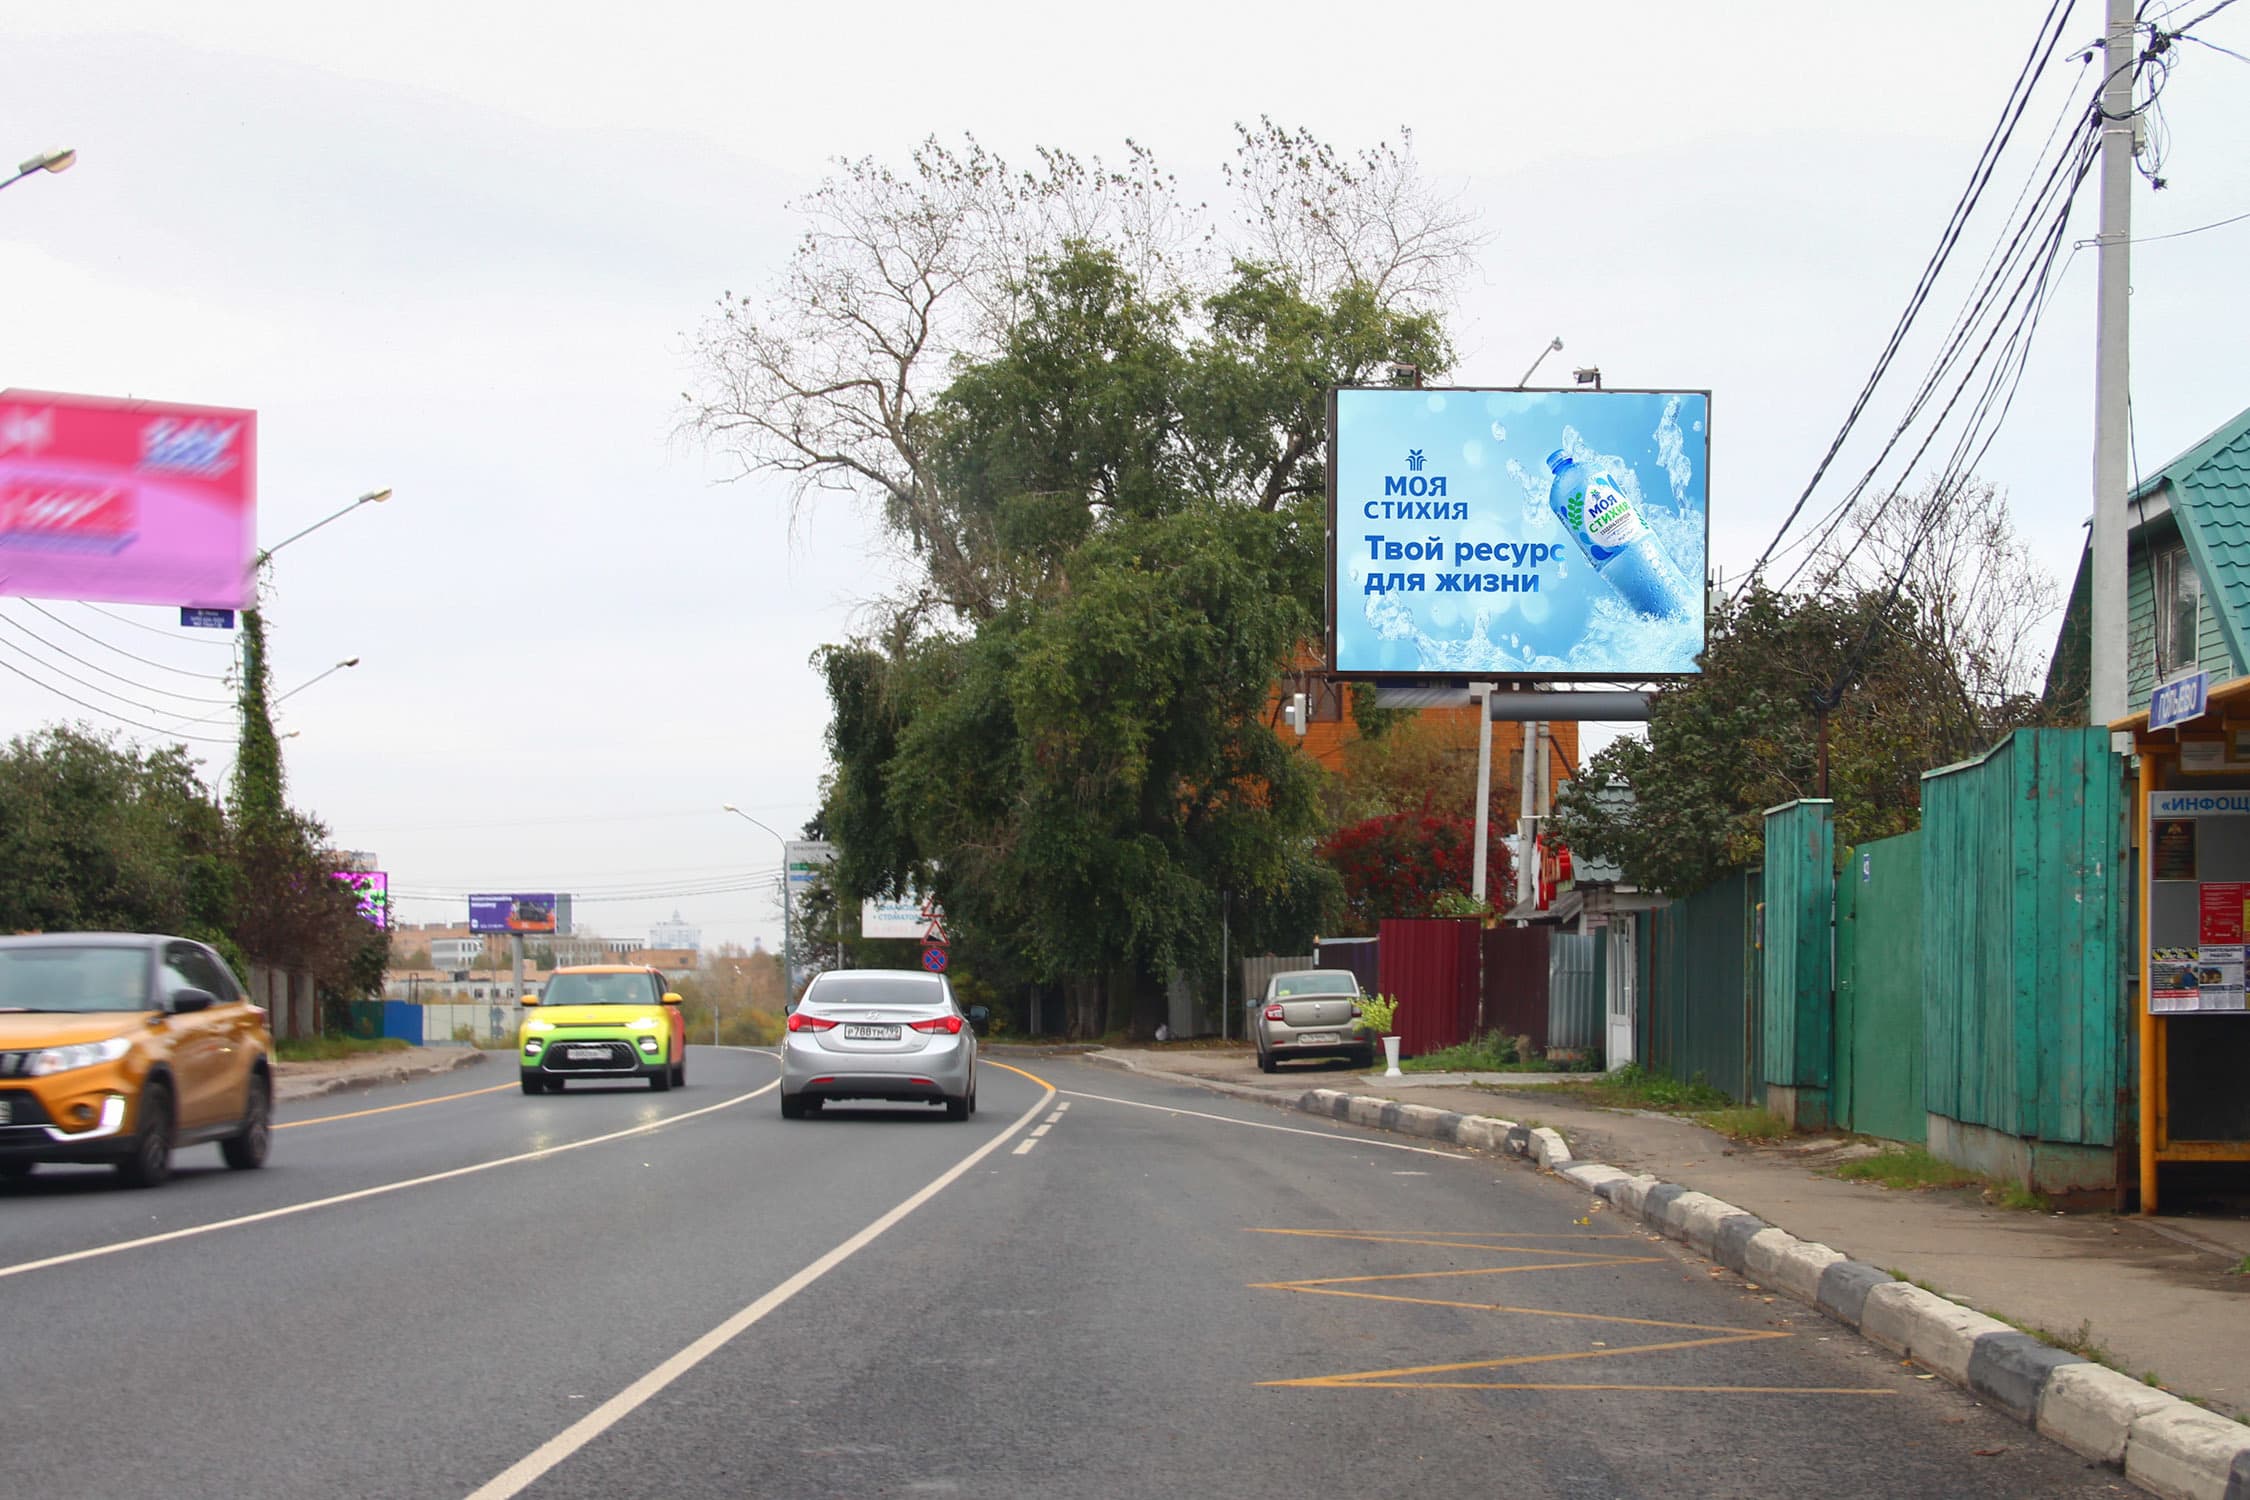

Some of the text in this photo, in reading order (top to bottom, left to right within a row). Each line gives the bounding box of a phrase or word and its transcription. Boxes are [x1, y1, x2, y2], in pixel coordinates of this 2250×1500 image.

[1384, 475, 1447, 497] МОЯ
[1363, 501, 1469, 521] СТИХИЯ
[1588, 494, 1618, 519] МОЯ
[1588, 501, 1631, 534] СТИХИЯ
[1364, 534, 1566, 568] Твой ресурс
[1363, 572, 1540, 596] для жизни
